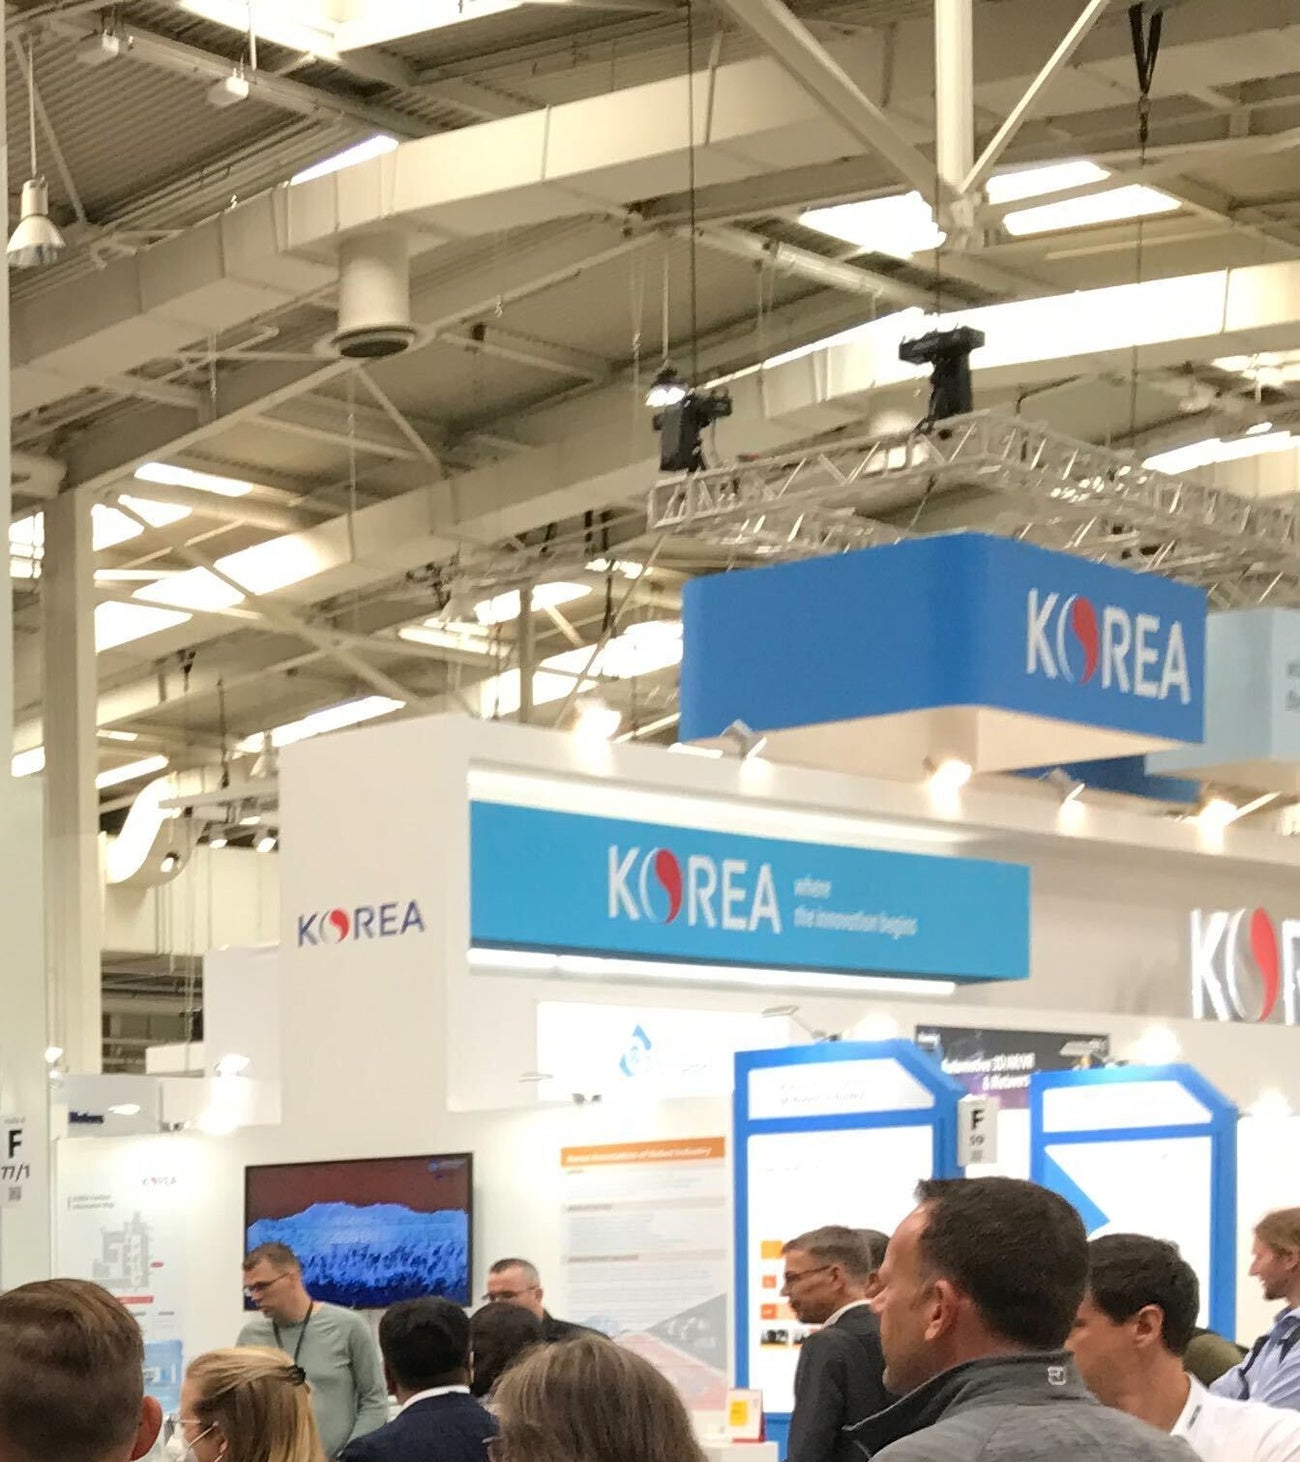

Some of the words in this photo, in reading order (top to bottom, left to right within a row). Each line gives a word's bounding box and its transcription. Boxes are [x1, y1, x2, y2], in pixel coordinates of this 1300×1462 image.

[1026, 588, 1191, 705] KOREA
[607, 845, 783, 934] KOREA
[298, 899, 424, 948] KOREA
[971, 1109, 985, 1130] F
[8, 1129, 22, 1159] F
[1, 1163, 30, 1182] 77/1
